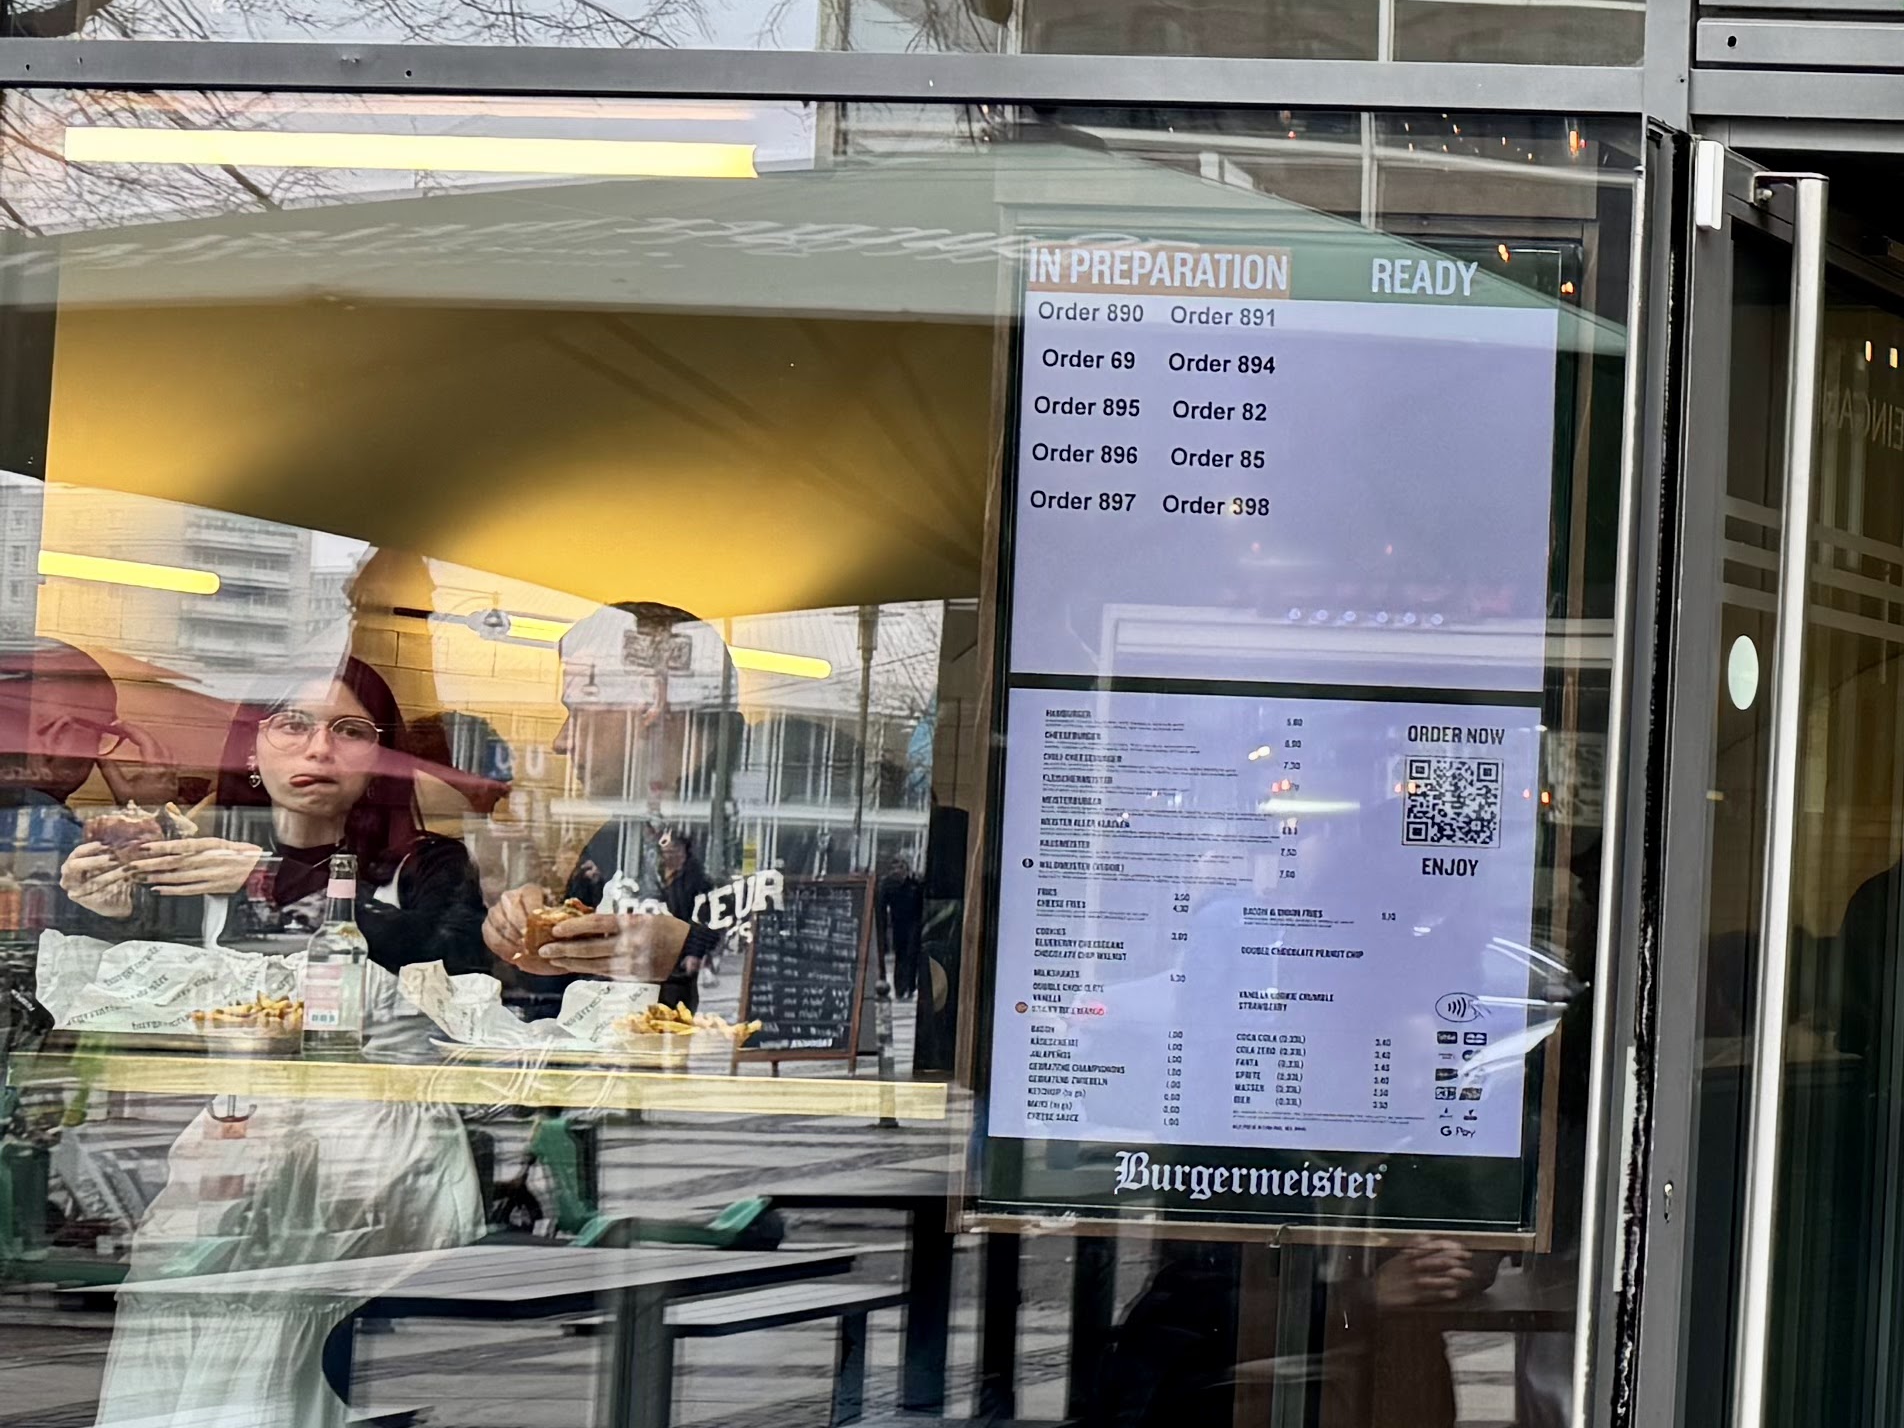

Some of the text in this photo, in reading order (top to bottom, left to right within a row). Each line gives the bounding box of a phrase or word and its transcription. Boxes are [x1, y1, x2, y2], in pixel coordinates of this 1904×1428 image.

[1029, 248, 1287, 292] IN PREPARATION
[1371, 258, 1478, 296] READY
[1038, 302, 1144, 324] Order 890
[1171, 306, 1276, 328] Order 891
[1042, 348, 1136, 370] Order 69
[1169, 353, 1276, 375] Order 894
[1034, 395, 1141, 417] Order 895
[1173, 400, 1268, 422] Order 82
[1031, 443, 1139, 466] Order 896
[1170, 448, 1265, 470] Order 85
[1030, 490, 1136, 513] Order 897
[1163, 495, 1224, 516] Order
[1408, 725, 1505, 745] ORDER NOW
[1422, 858, 1479, 876] ENJOY
[1113, 1150, 1382, 1200] Burgermeister
